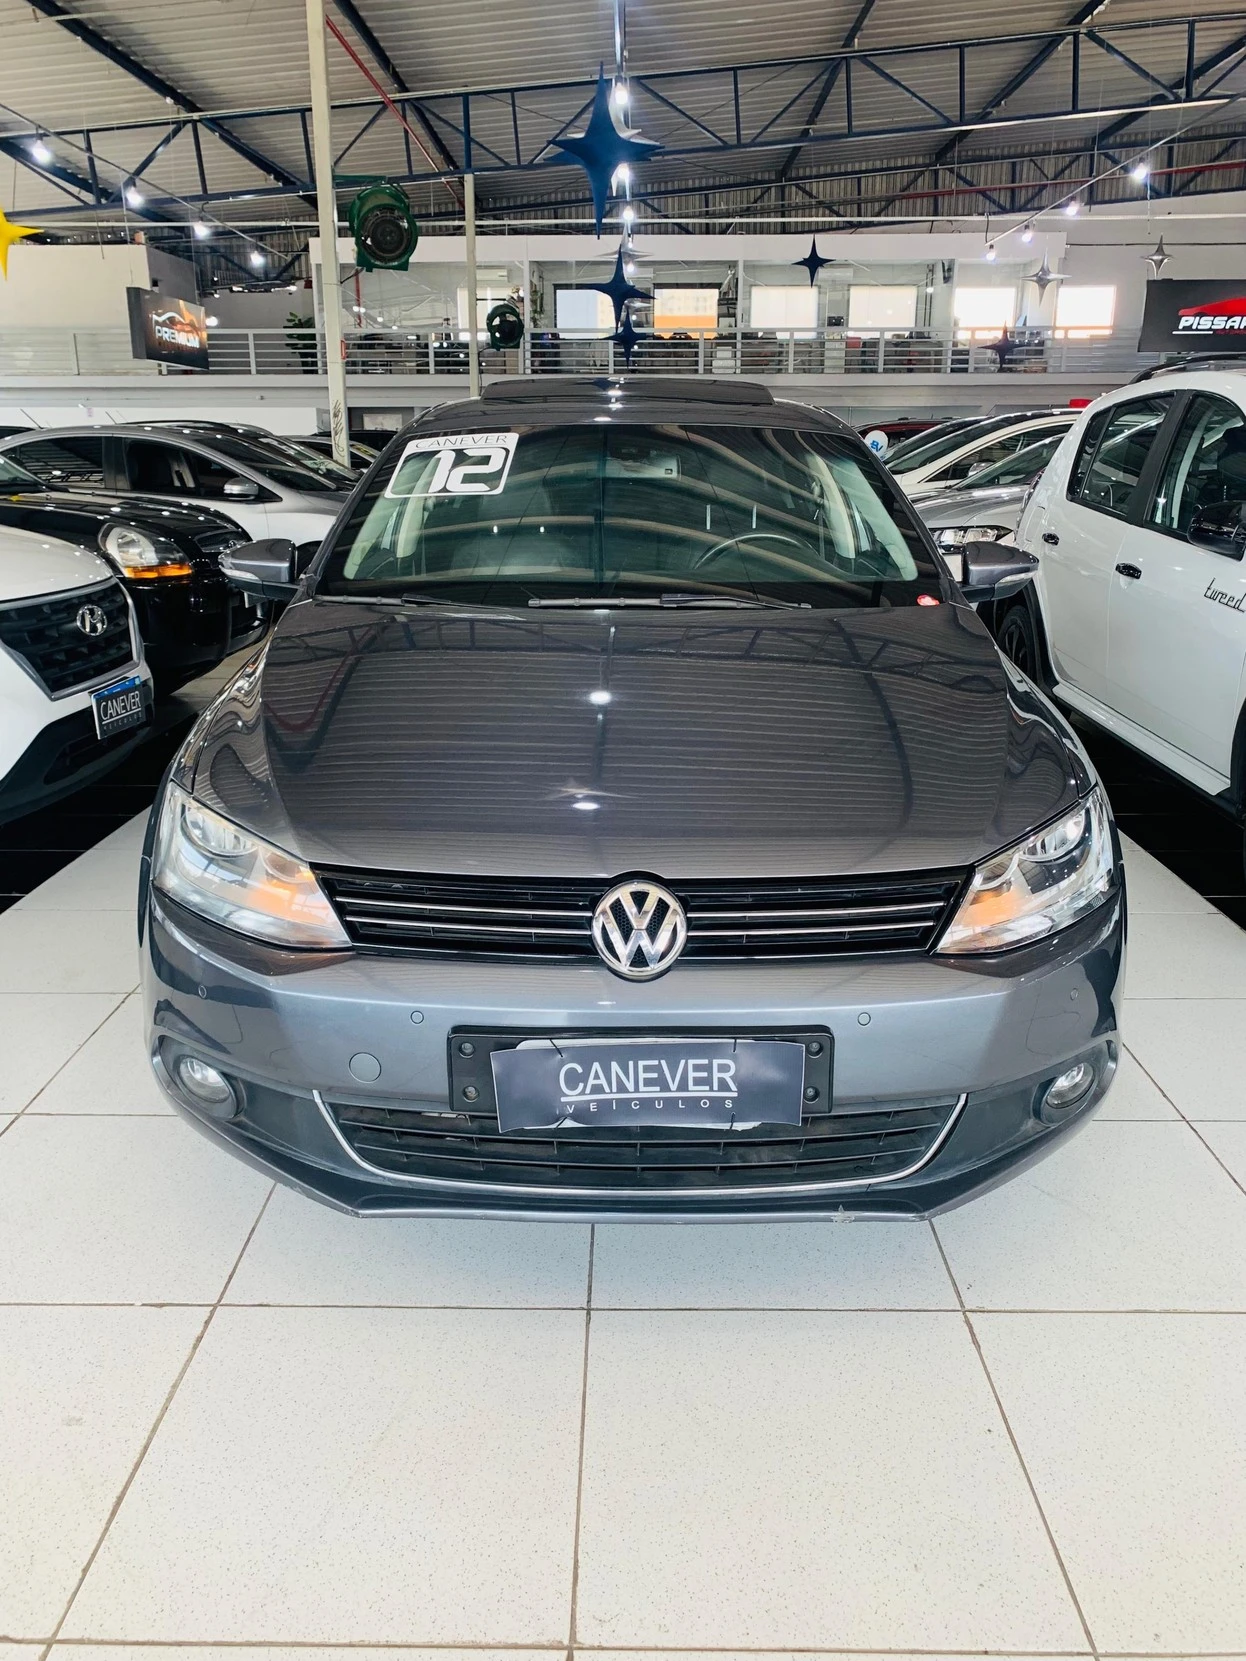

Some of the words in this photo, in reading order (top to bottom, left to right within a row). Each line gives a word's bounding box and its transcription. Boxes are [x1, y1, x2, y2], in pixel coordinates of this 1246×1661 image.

[415, 435, 507, 449] CANEVER
[428, 447, 507, 493] 12
[100, 691, 141, 721] CANEVER
[558, 1059, 738, 1096] CANEVER
